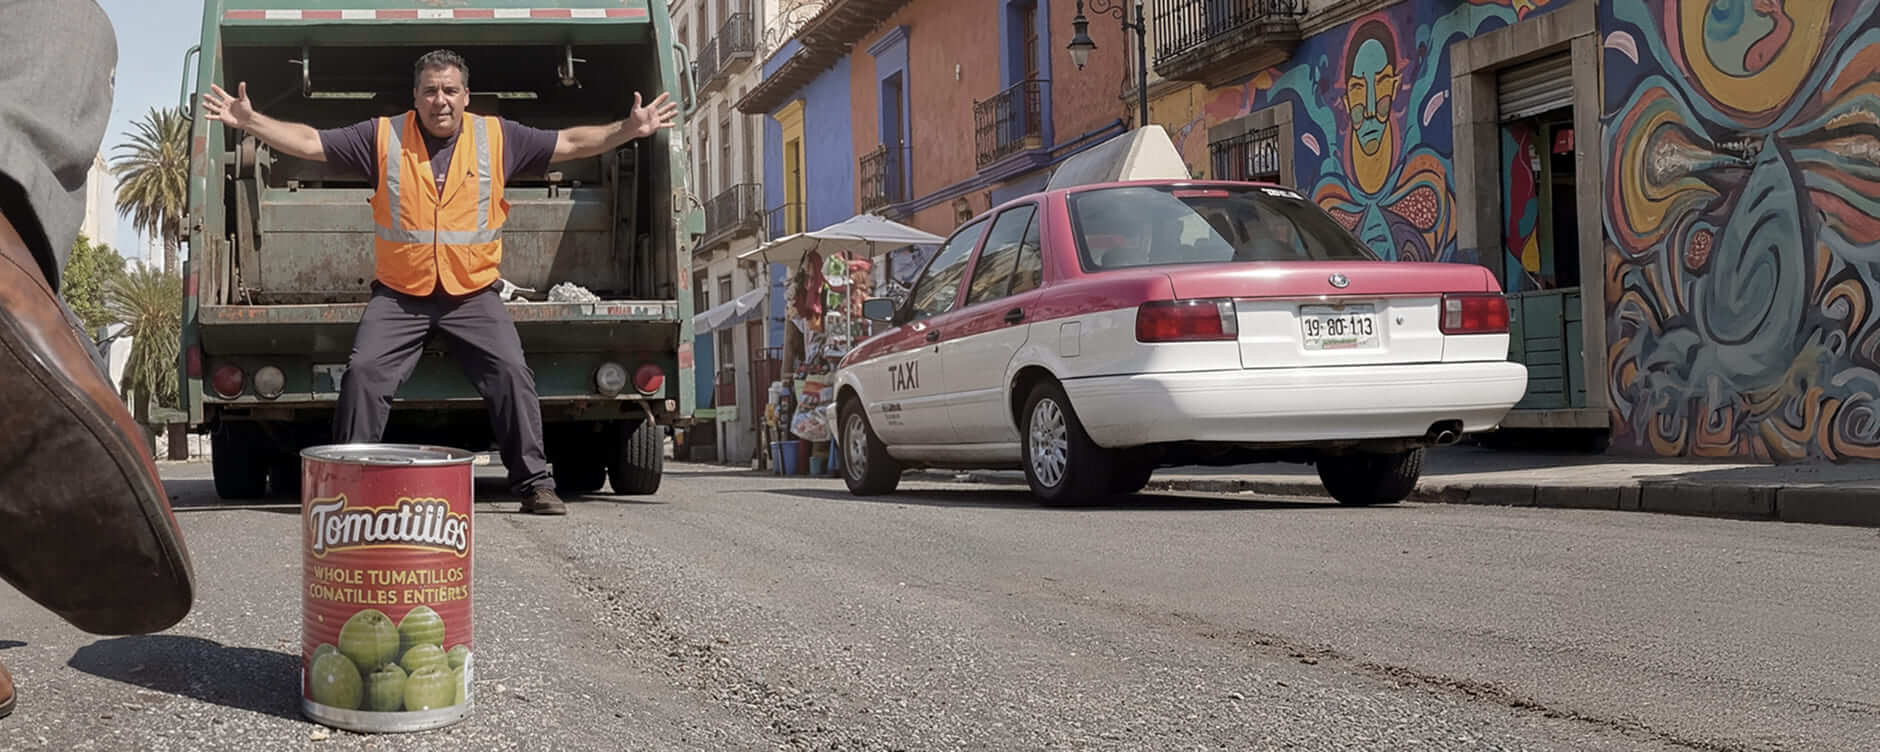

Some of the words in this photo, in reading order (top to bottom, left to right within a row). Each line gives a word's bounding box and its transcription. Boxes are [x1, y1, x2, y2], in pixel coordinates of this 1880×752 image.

[888, 360, 919, 392] TAXI
[310, 499, 468, 551] Tomatillos
[313, 566, 364, 584] WHOLE
[367, 567, 464, 585] TUMATILLOS
[310, 583, 398, 605] CONATILLES
